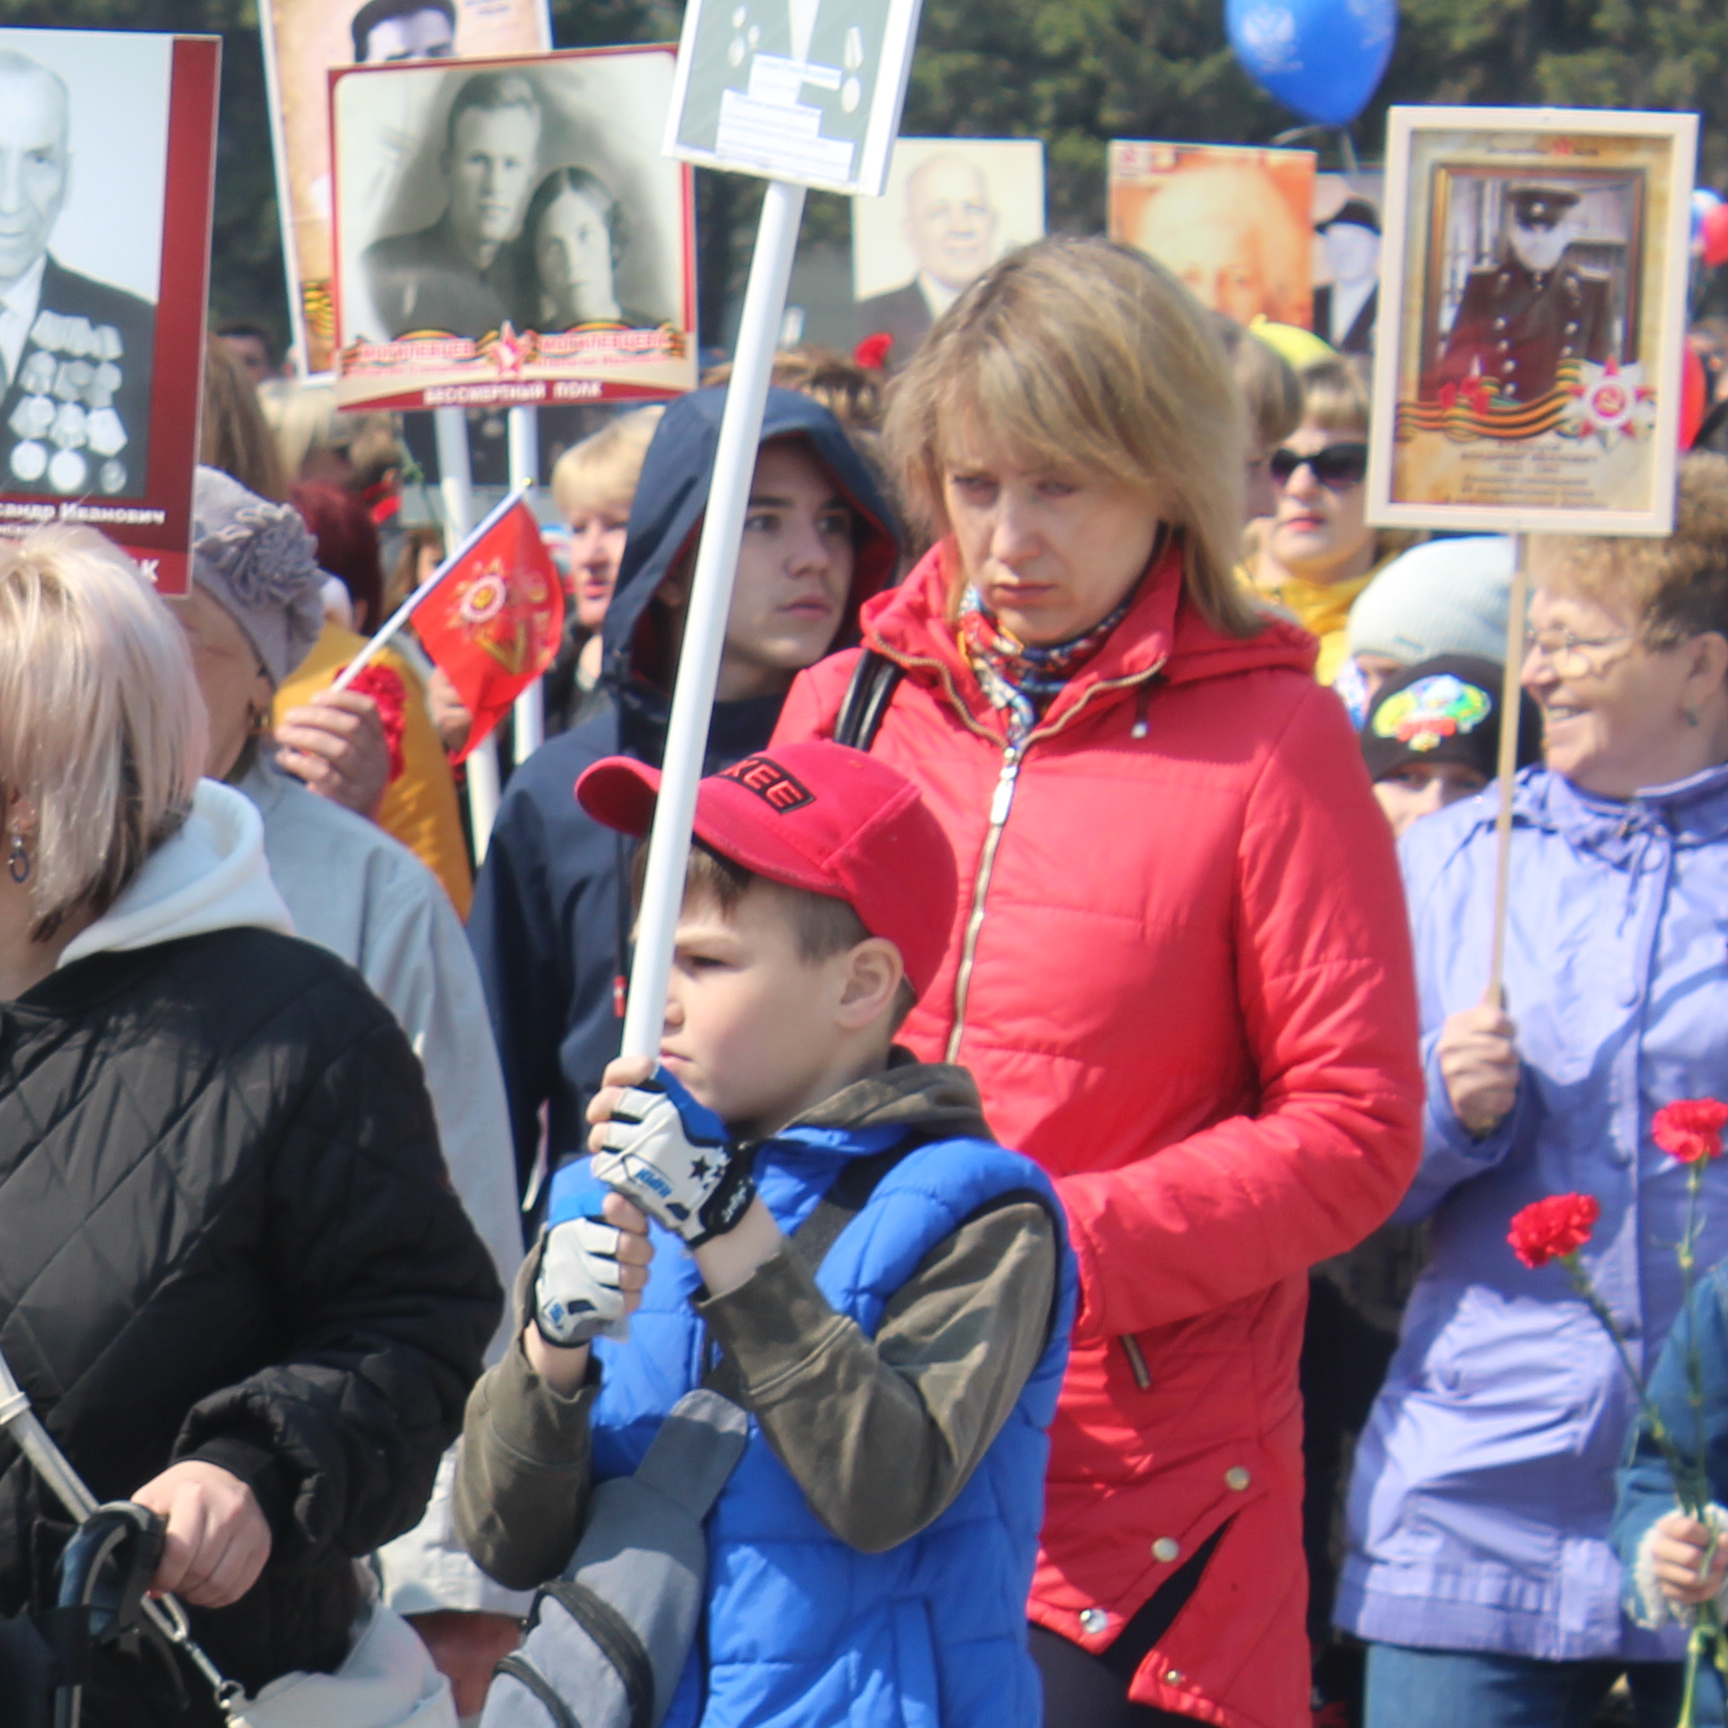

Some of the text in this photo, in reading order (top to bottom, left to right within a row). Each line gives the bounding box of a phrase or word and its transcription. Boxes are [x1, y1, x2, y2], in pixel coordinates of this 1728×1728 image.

[423, 379, 602, 405] БЕССМЕРТНЫЙ ПОЛК
[59, 501, 166, 525] Иванович
[718, 759, 805, 809] KEE
